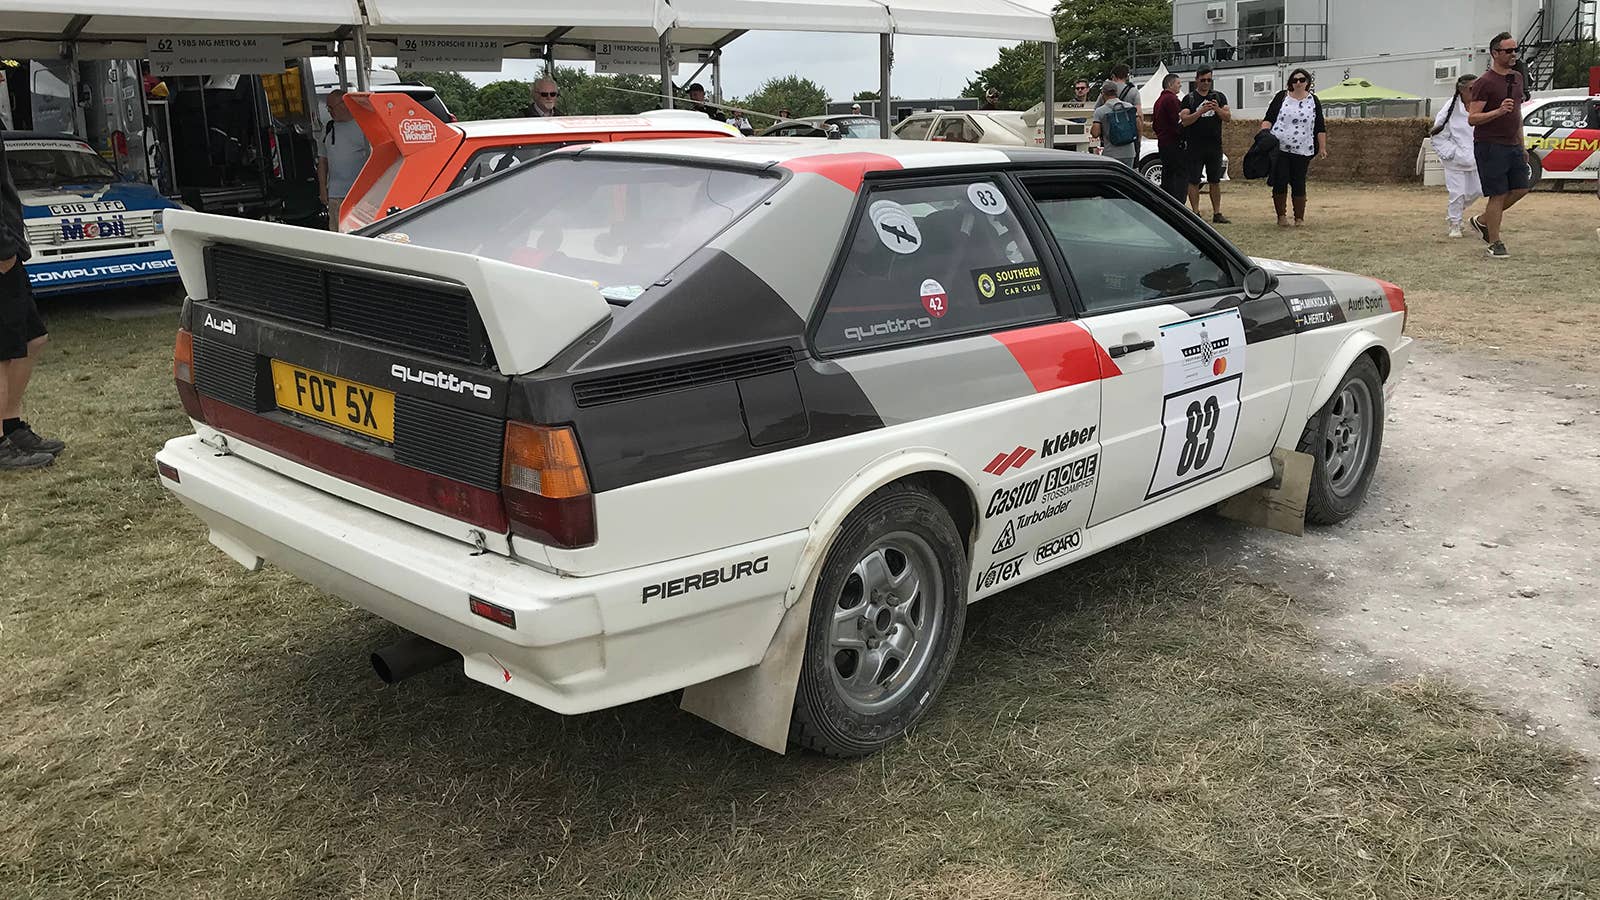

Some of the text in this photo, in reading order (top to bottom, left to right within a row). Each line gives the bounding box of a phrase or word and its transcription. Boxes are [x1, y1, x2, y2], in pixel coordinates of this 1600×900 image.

[158, 40, 173, 50] 62
[405, 40, 417, 49] 96
[437, 40, 465, 48] PORSCHE
[603, 44, 611, 53] 81
[404, 121, 432, 131] Golden
[403, 130, 434, 141] Wonder
[95, 201, 124, 212] FFC
[976, 190, 997, 206] 83
[61, 214, 126, 240] Mobil
[995, 266, 1041, 282] SOUTHERN
[1004, 283, 1041, 296] CAR CLUB
[929, 297, 944, 311] 42
[1348, 295, 1384, 312] Audi Sport
[204, 313, 237, 336] Audi
[844, 317, 932, 341] quattro
[391, 363, 492, 400] quattro
[294, 370, 379, 430] FOT 5X
[1041, 424, 1097, 459] kléber
[1176, 395, 1221, 477] 83
[985, 453, 1098, 519] Castrol BOGE
[1016, 500, 1072, 530] Turbolader
[1035, 531, 1080, 562] RECARO
[642, 555, 769, 604] PIERBURG
